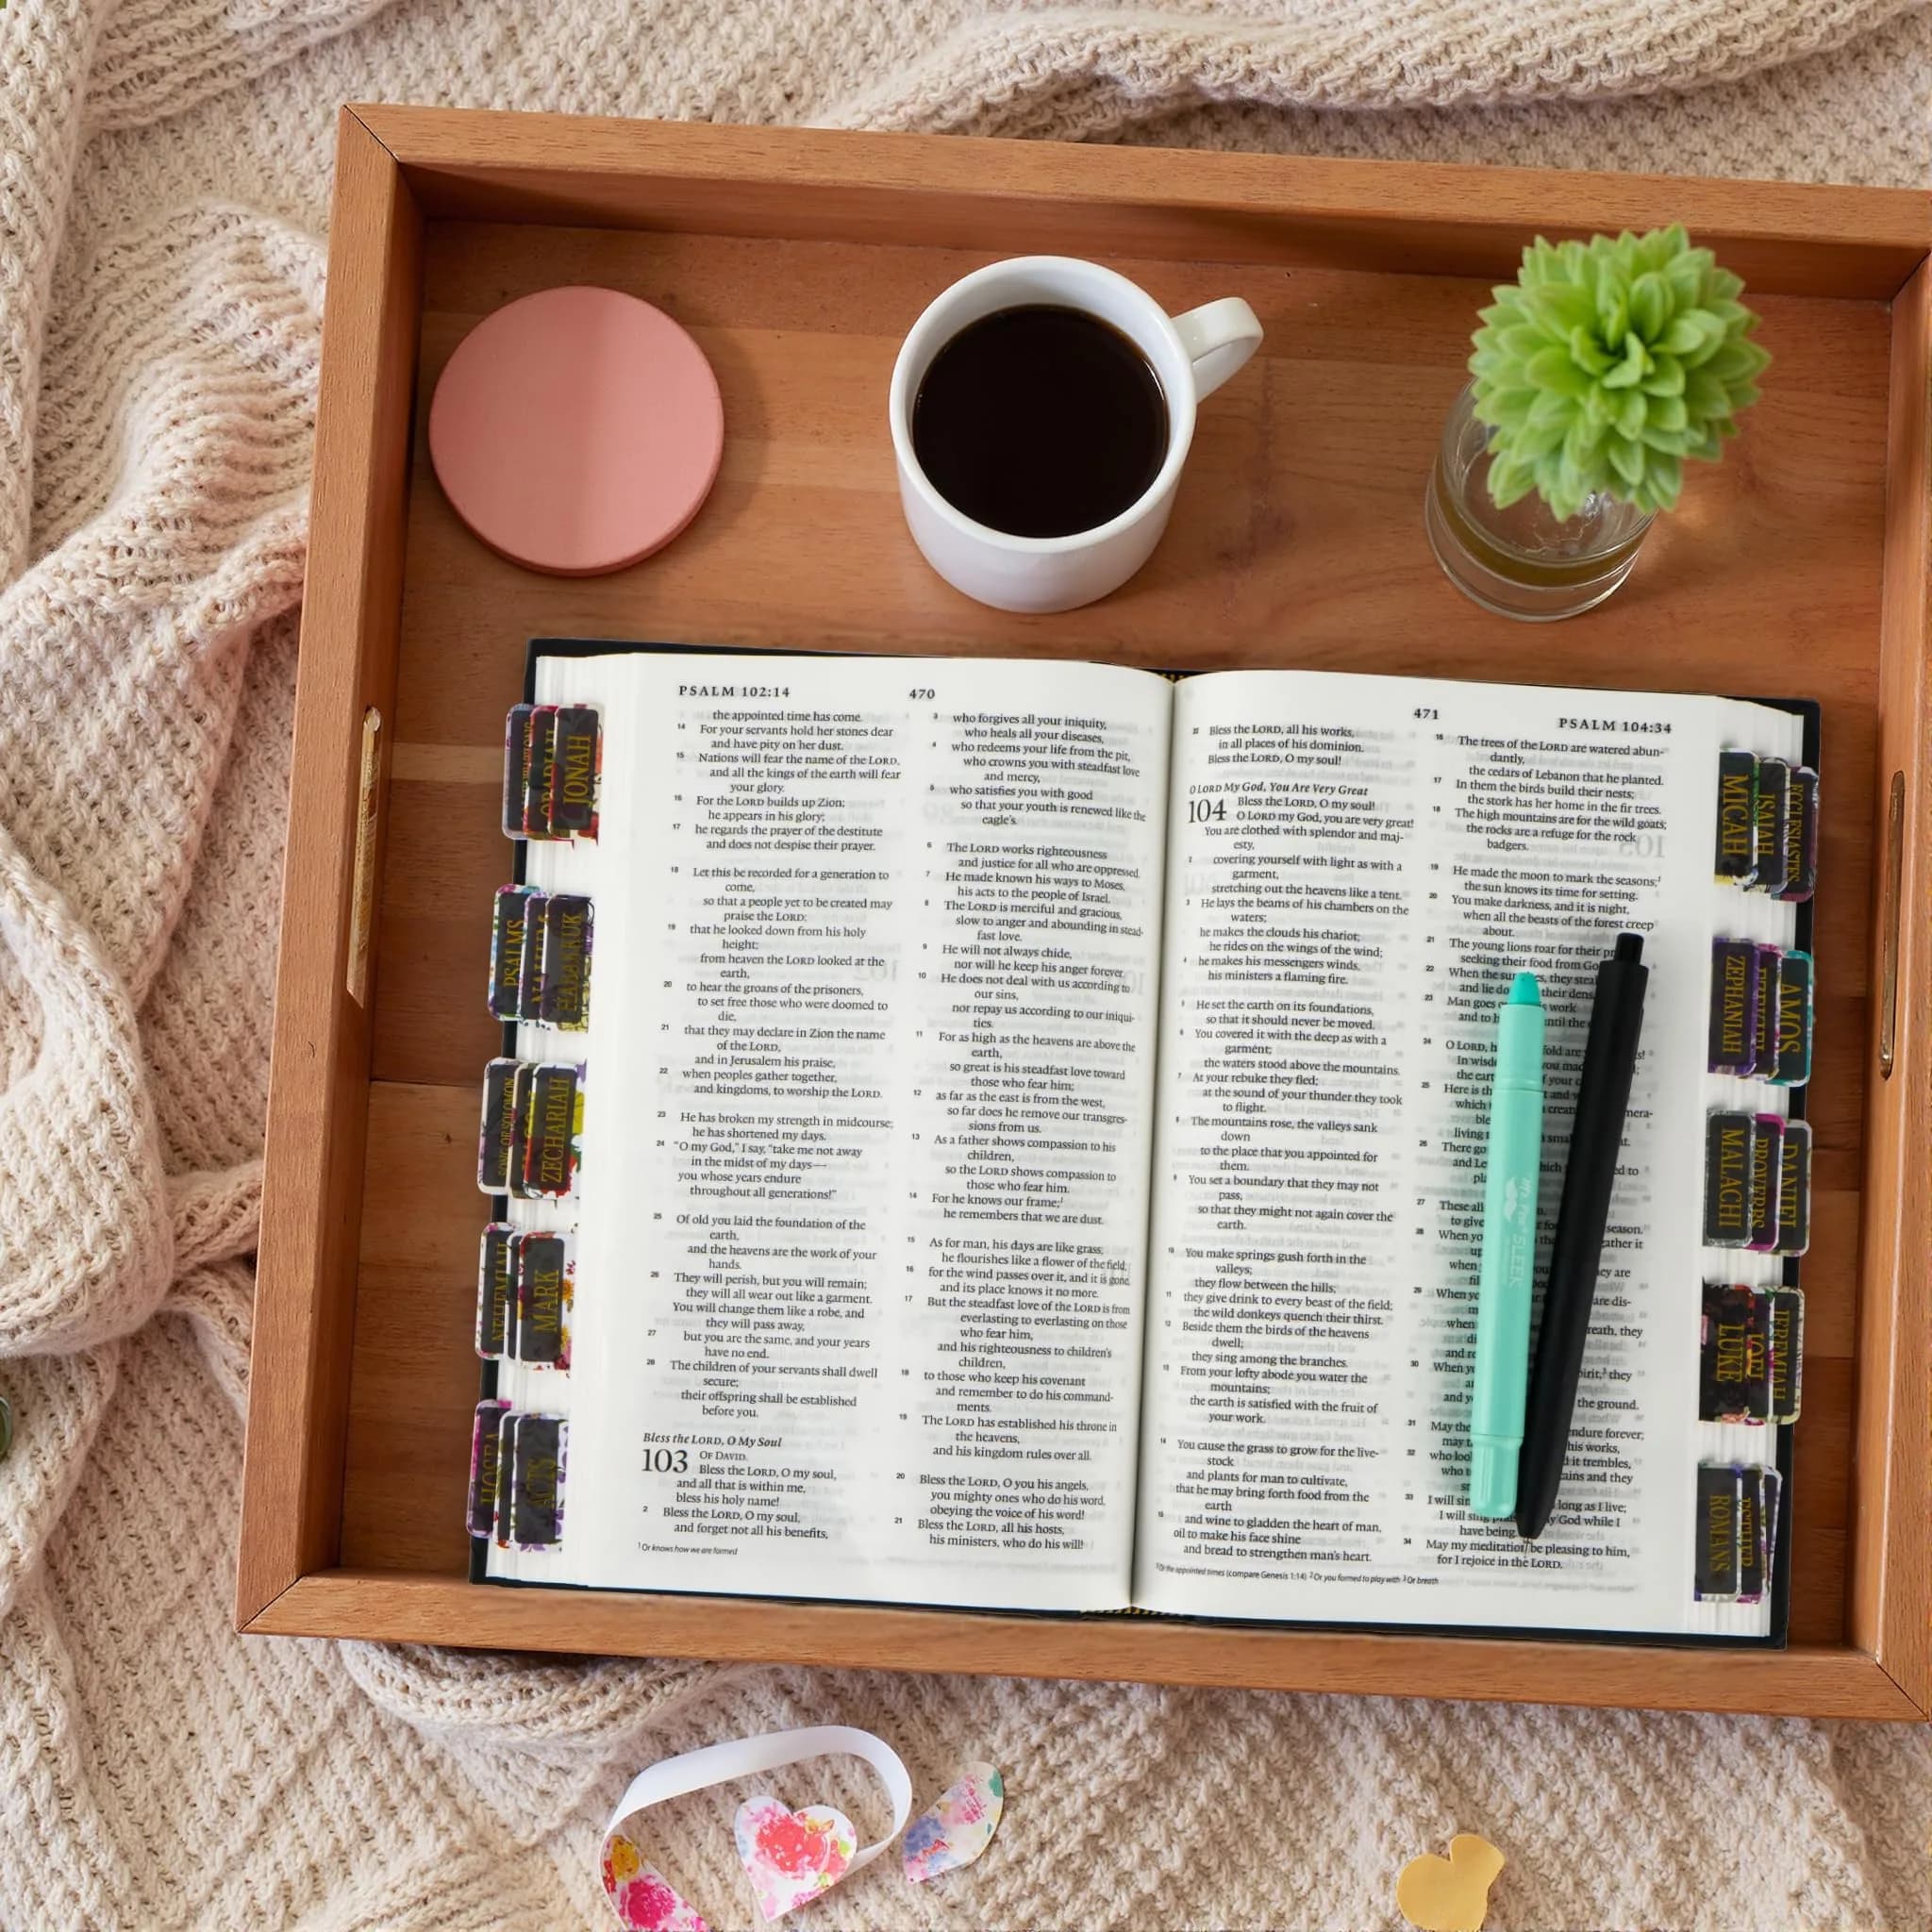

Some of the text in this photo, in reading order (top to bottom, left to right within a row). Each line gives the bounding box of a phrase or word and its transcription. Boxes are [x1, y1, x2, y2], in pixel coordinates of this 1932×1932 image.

[678, 685, 790, 698] PSALM 102:14
[908, 689, 936, 700] 470
[712, 709, 731, 721] the
[731, 709, 785, 723] appointed
[786, 710, 811, 722] time
[812, 710, 831, 723] has
[953, 712, 976, 724] who
[977, 712, 1020, 726] forgives
[1021, 713, 1035, 724] all
[1036, 717, 1062, 727] your
[1413, 708, 1439, 721] 471
[700, 724, 718, 734] For
[719, 726, 744, 737] your
[745, 726, 788, 736] servants
[790, 724, 814, 736] hold
[816, 725, 835, 737] her
[836, 727, 869, 737] stones
[870, 726, 894, 737] dear
[1209, 724, 1355, 739] Bless the LORD, all his works,
[1558, 717, 1672, 735] PSALM 104:34
[563, 735, 591, 808] JONAH
[1469, 764, 1664, 786] the cedars of Lebanon that he planted.
[1190, 781, 1369, 796] O LORD My God, You Are Very Great
[1190, 798, 1227, 824] 104
[1238, 795, 1375, 811] Bless the LORD, O my soul!
[1722, 774, 1748, 855] MICAH
[695, 824, 708, 835] he
[710, 824, 749, 837] regards
[751, 824, 768, 836] the
[770, 827, 804, 838] prayer
[804, 825, 817, 836] of
[818, 825, 836, 836] the
[836, 825, 883, 837] destitute
[946, 841, 968, 853] The
[969, 842, 1000, 854] LORD
[1002, 843, 1035, 856] works
[1036, 845, 1108, 860] righteousness
[1208, 970, 1348, 986] his ministers a flaming fire.
[1723, 956, 1745, 1054] ZEPHANIAH
[1779, 983, 1802, 1053] AMOS
[541, 1077, 569, 1183] ZECHARIAH
[1718, 1128, 1743, 1228] MALACHI
[690, 1184, 751, 1199] throughout
[752, 1187, 766, 1198] all
[532, 1270, 559, 1333] MARK
[1184, 1291, 1204, 1304] they
[1206, 1292, 1227, 1305] give
[1228, 1292, 1259, 1305] drink
[1260, 1295, 1273, 1306] to
[1274, 1297, 1304, 1308] every
[1305, 1295, 1333, 1308] beast
[1334, 1298, 1347, 1308] of
[1348, 1298, 1366, 1310] the
[1367, 1299, 1393, 1311] field;
[1716, 1324, 1744, 1382] LUKE
[642, 1432, 782, 1449] Bless the LORD, O My Soul
[641, 1448, 690, 1474] 103
[699, 1450, 713, 1460] OF
[698, 1463, 837, 1480] Bless the LORD, O my soul,
[929, 1504, 1085, 1521] obeying the voice of his word!
[1708, 1494, 1730, 1572] ROMANS
[1183, 1543, 1202, 1555] and
[1204, 1543, 1234, 1557] bread
[1235, 1547, 1248, 1557] to
[1248, 1548, 1307, 1561] strengthen
[1342, 1550, 1372, 1562] heart.
[1437, 1554, 1563, 1570] for I rejoice in the LORD.
